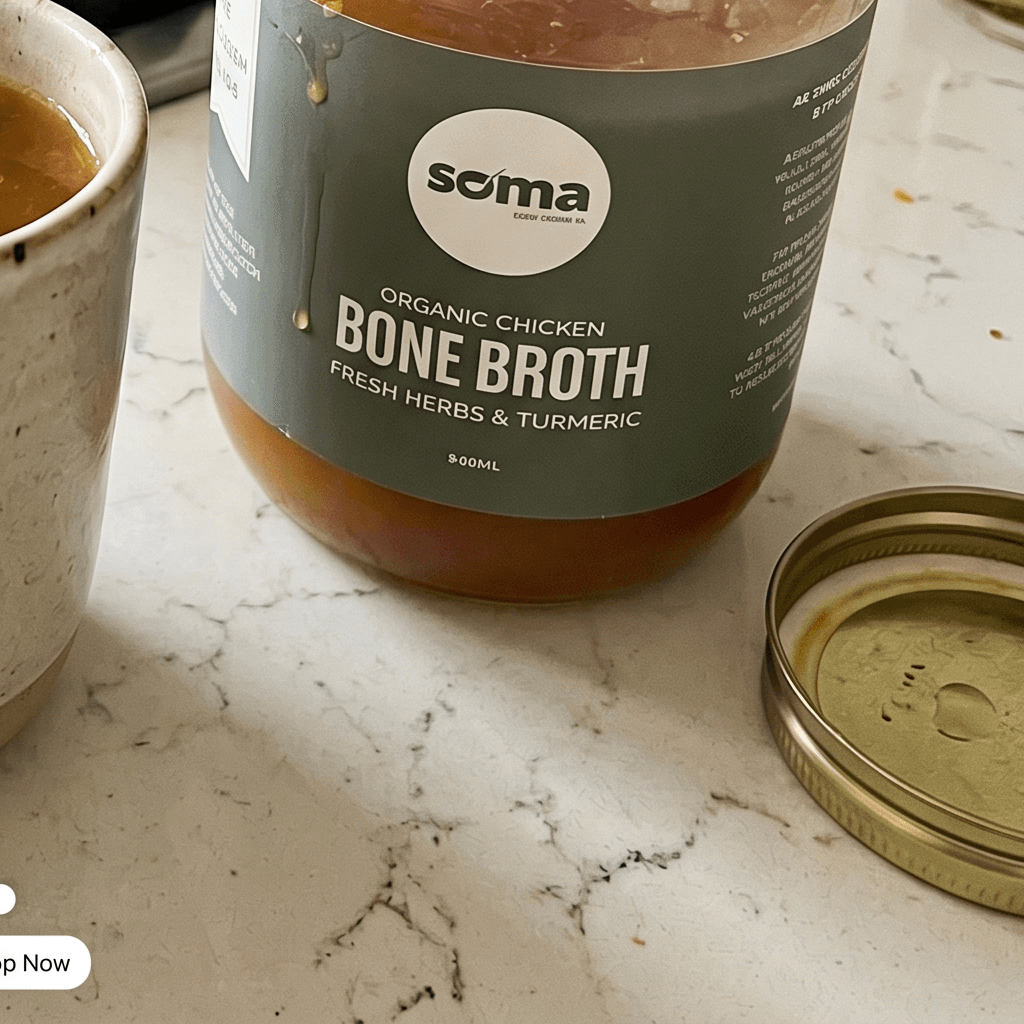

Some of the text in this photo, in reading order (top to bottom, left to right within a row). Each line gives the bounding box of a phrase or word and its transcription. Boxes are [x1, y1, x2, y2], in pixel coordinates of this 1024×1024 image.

[336, 294, 464, 387] BONE
[476, 339, 650, 401] BROTH
[381, 287, 605, 337] ORGANIC CHICKEN
[330, 359, 642, 430] FRESH HERBS & TURMERIC
